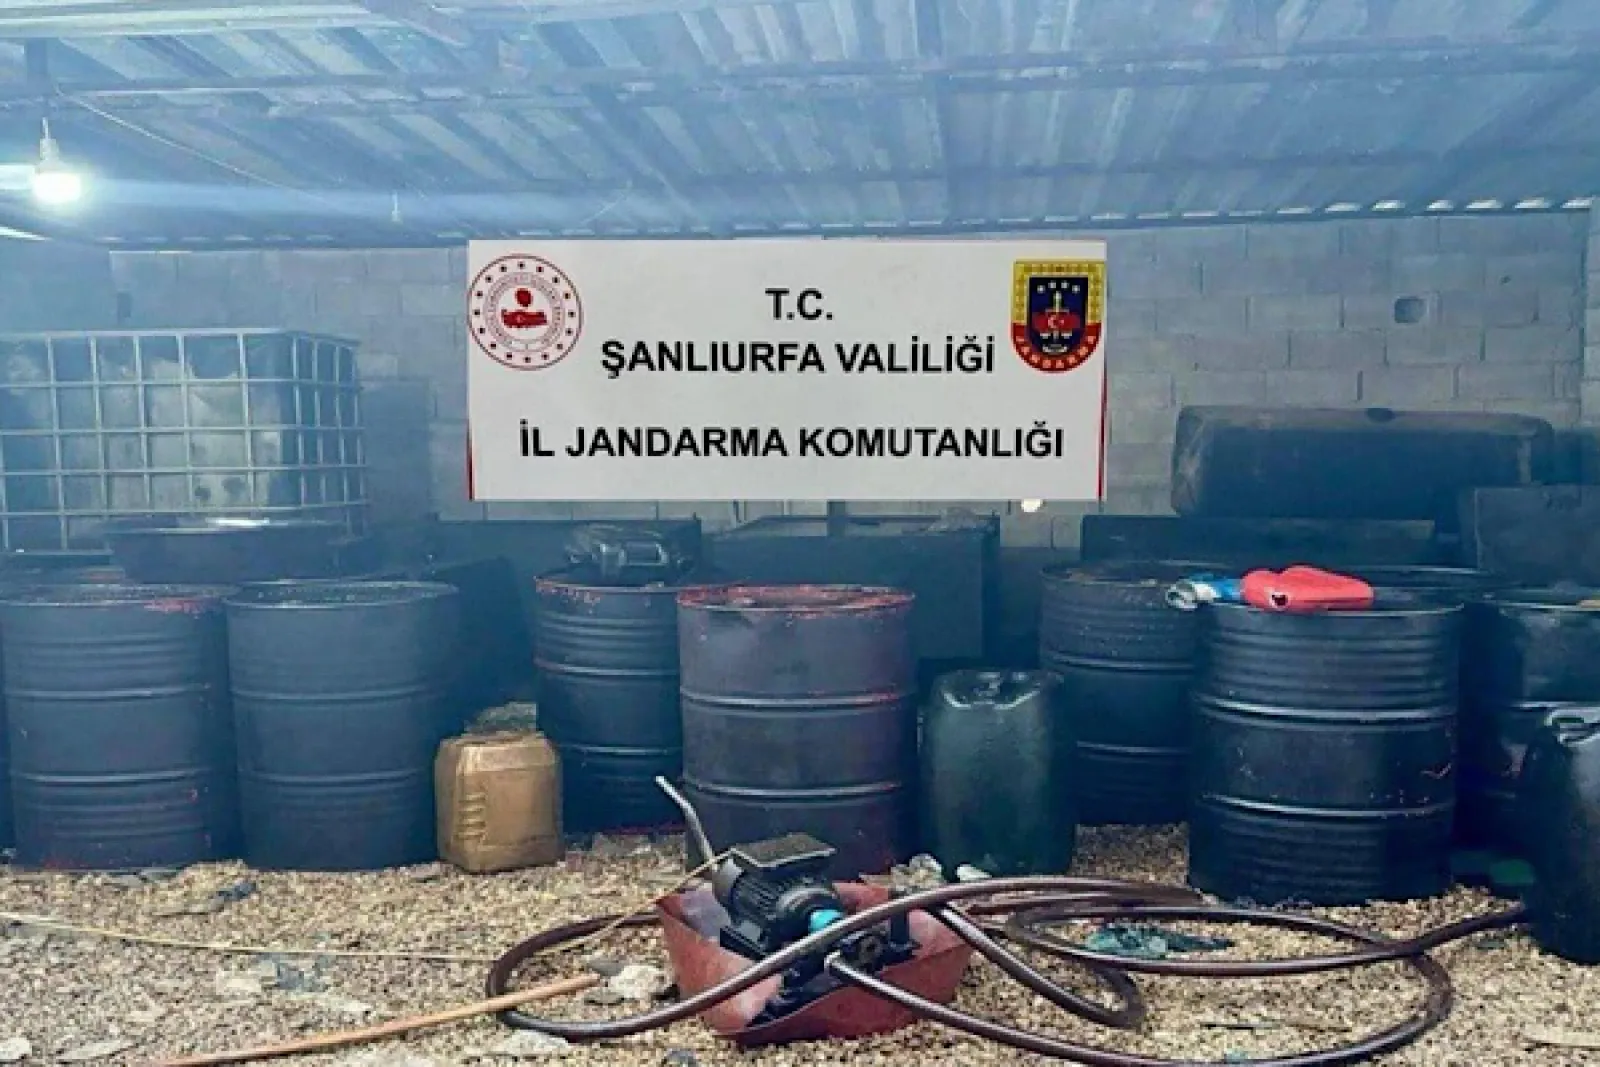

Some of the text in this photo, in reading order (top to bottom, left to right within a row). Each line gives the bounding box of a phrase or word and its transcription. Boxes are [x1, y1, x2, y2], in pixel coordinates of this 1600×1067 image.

[765, 288, 833, 320] T.C.
[602, 341, 825, 379] ŞANLIURFA
[835, 335, 995, 373] VALİLİĞİ
[520, 419, 1063, 457] İL JANDARMA KOMUTANLIĞI
